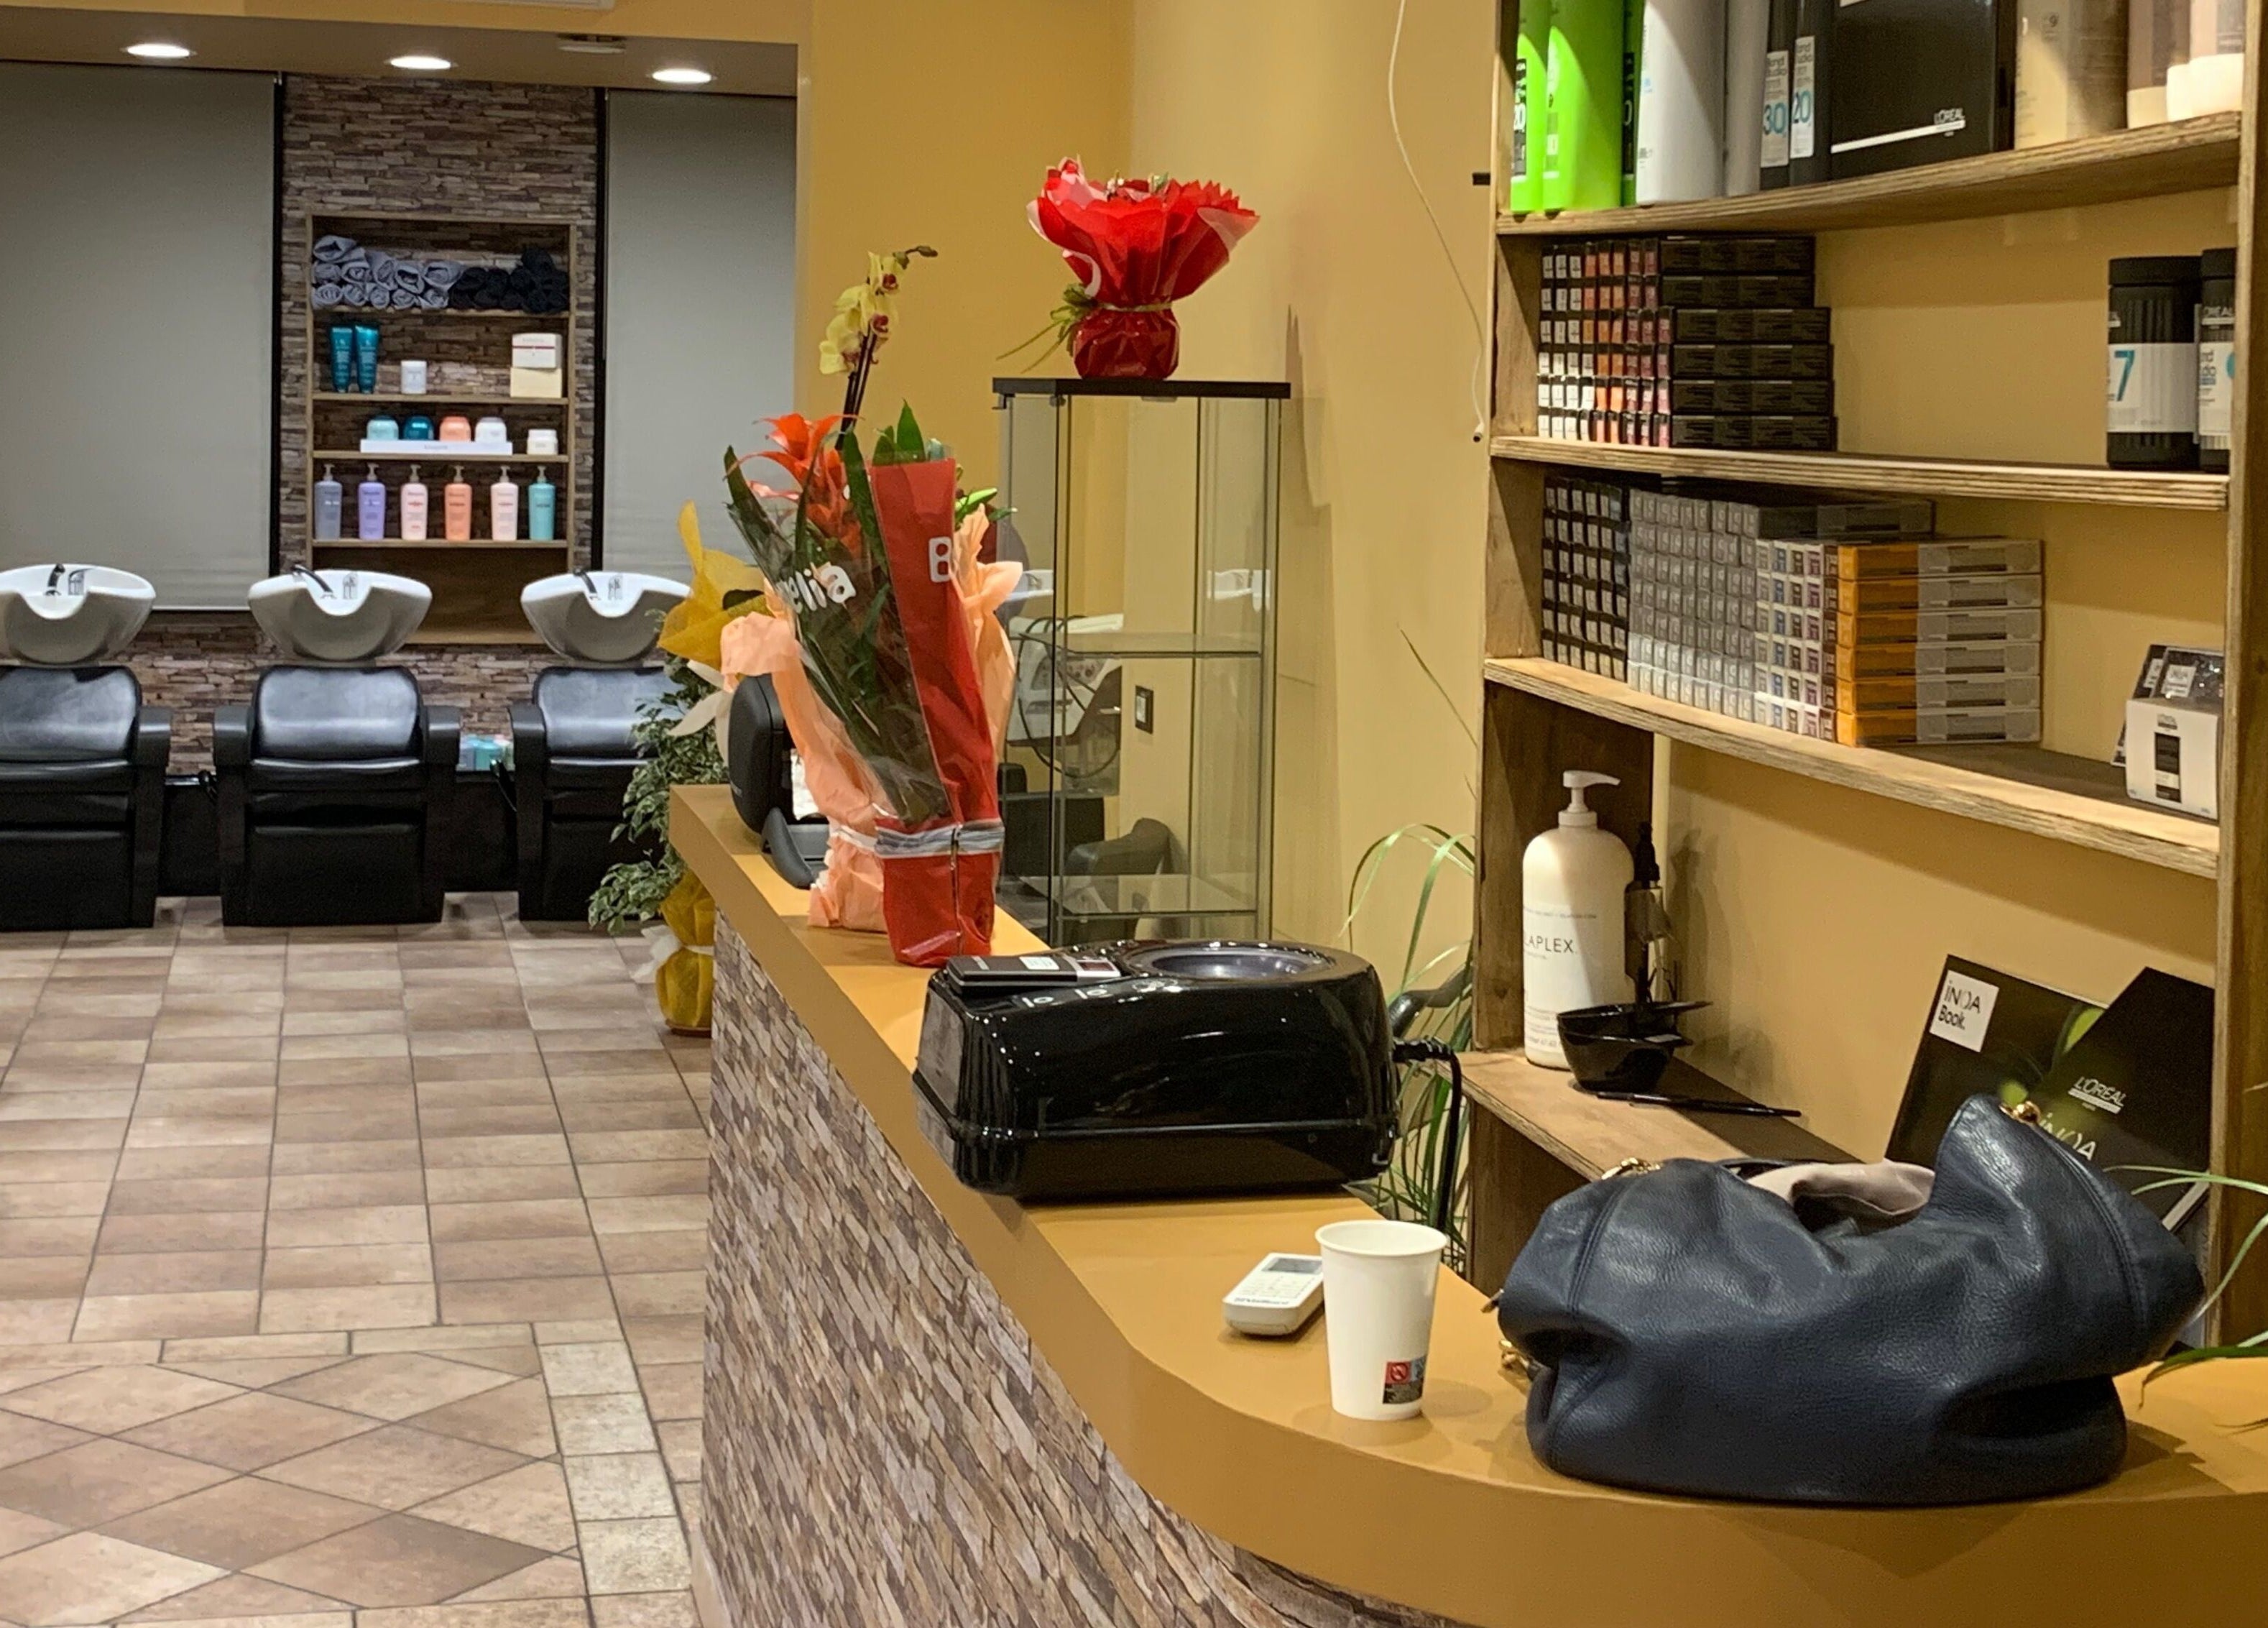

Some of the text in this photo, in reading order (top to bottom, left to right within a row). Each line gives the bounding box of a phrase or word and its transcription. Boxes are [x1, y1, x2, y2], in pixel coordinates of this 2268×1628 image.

[1764, 102, 1786, 135] 30
[1793, 91, 1812, 124] 20
[2114, 350, 2135, 401] 7
[928, 536, 952, 583] B
